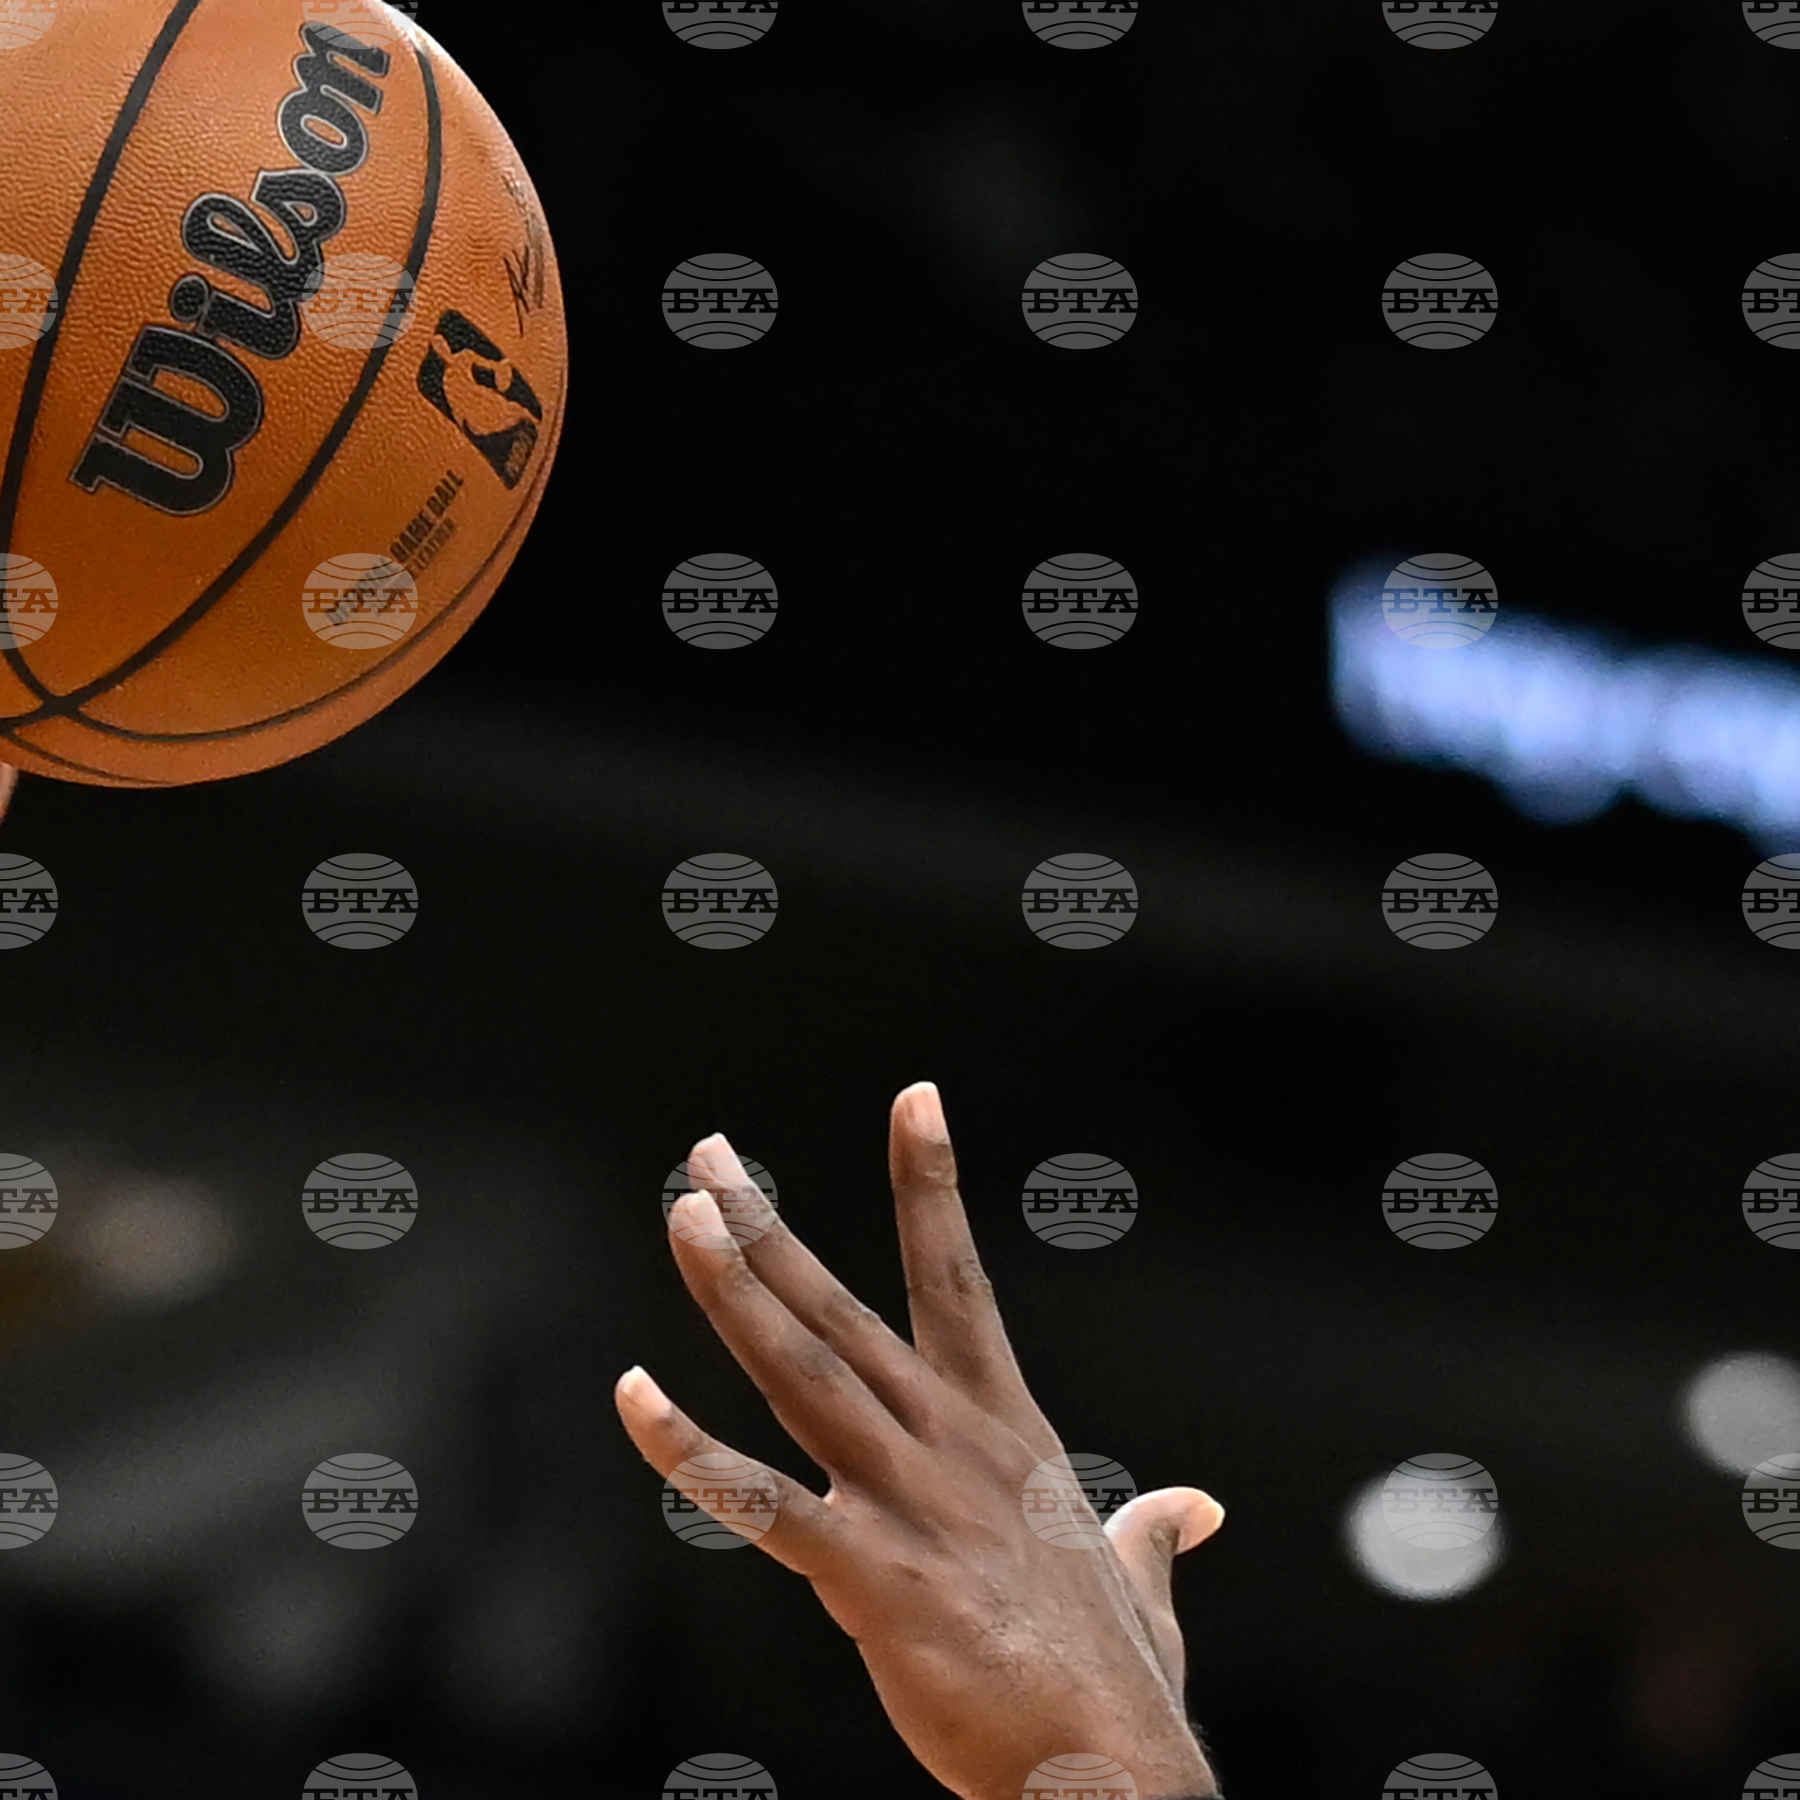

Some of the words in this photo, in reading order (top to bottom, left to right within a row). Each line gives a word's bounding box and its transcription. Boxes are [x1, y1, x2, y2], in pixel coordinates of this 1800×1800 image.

[69, 20, 391, 516] Wilson
[390, 508, 436, 563] GAME
[425, 468, 465, 517] BALL
